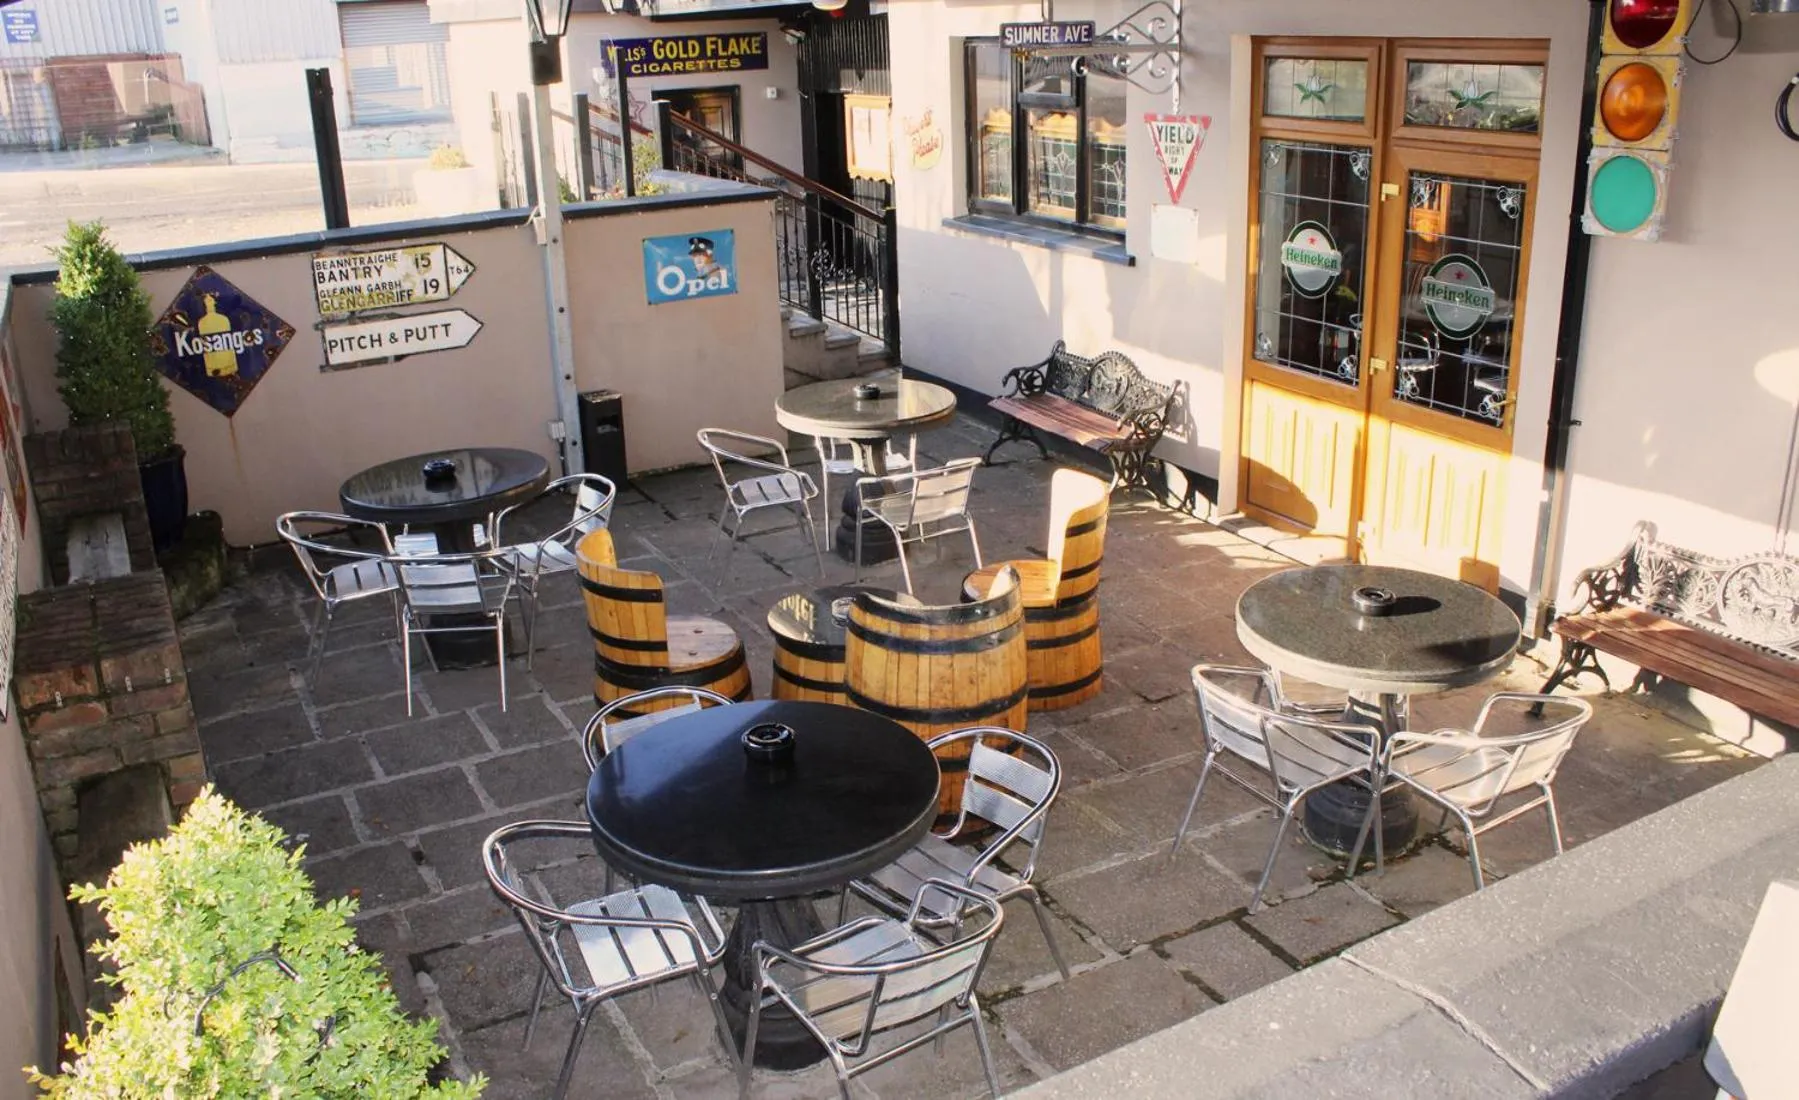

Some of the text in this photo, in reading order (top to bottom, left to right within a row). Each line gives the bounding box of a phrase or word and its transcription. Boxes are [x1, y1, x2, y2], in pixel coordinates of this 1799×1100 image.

[1004, 26, 1059, 45] SUMNER
[631, 58, 742, 74] CIGARETTES
[1156, 125, 1194, 144] YIELD
[1168, 167, 1183, 176] WAY
[414, 252, 432, 270] 15
[1285, 247, 1338, 269] Heineken
[317, 265, 384, 284] BANTRY
[657, 265, 729, 296] Opel
[366, 280, 402, 293] GARBH
[423, 278, 440, 295] 19
[1425, 282, 1490, 309] Heineken
[321, 288, 414, 311] GLENGARRIFF
[328, 323, 452, 354] PITCH & PUTT
